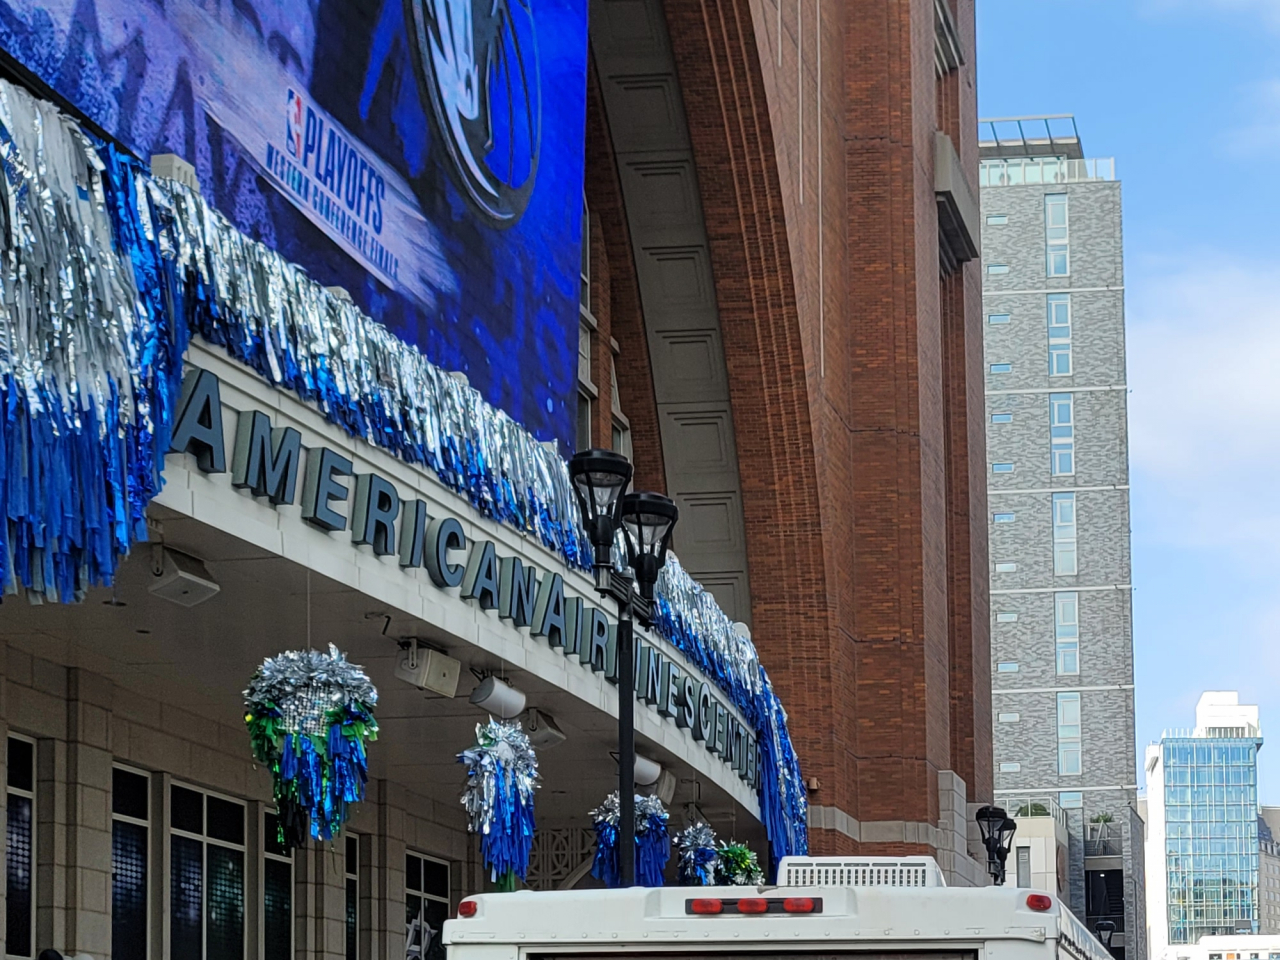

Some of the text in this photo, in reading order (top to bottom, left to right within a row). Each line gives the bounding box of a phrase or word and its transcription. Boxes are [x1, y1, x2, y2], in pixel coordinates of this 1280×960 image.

[266, 141, 310, 203] WESTERN
[312, 184, 368, 256] CONFERENCE
[303, 105, 386, 236] PLAYOFFS
[171, 367, 536, 627] AMERICAN
[530, 572, 695, 728] AIRINES
